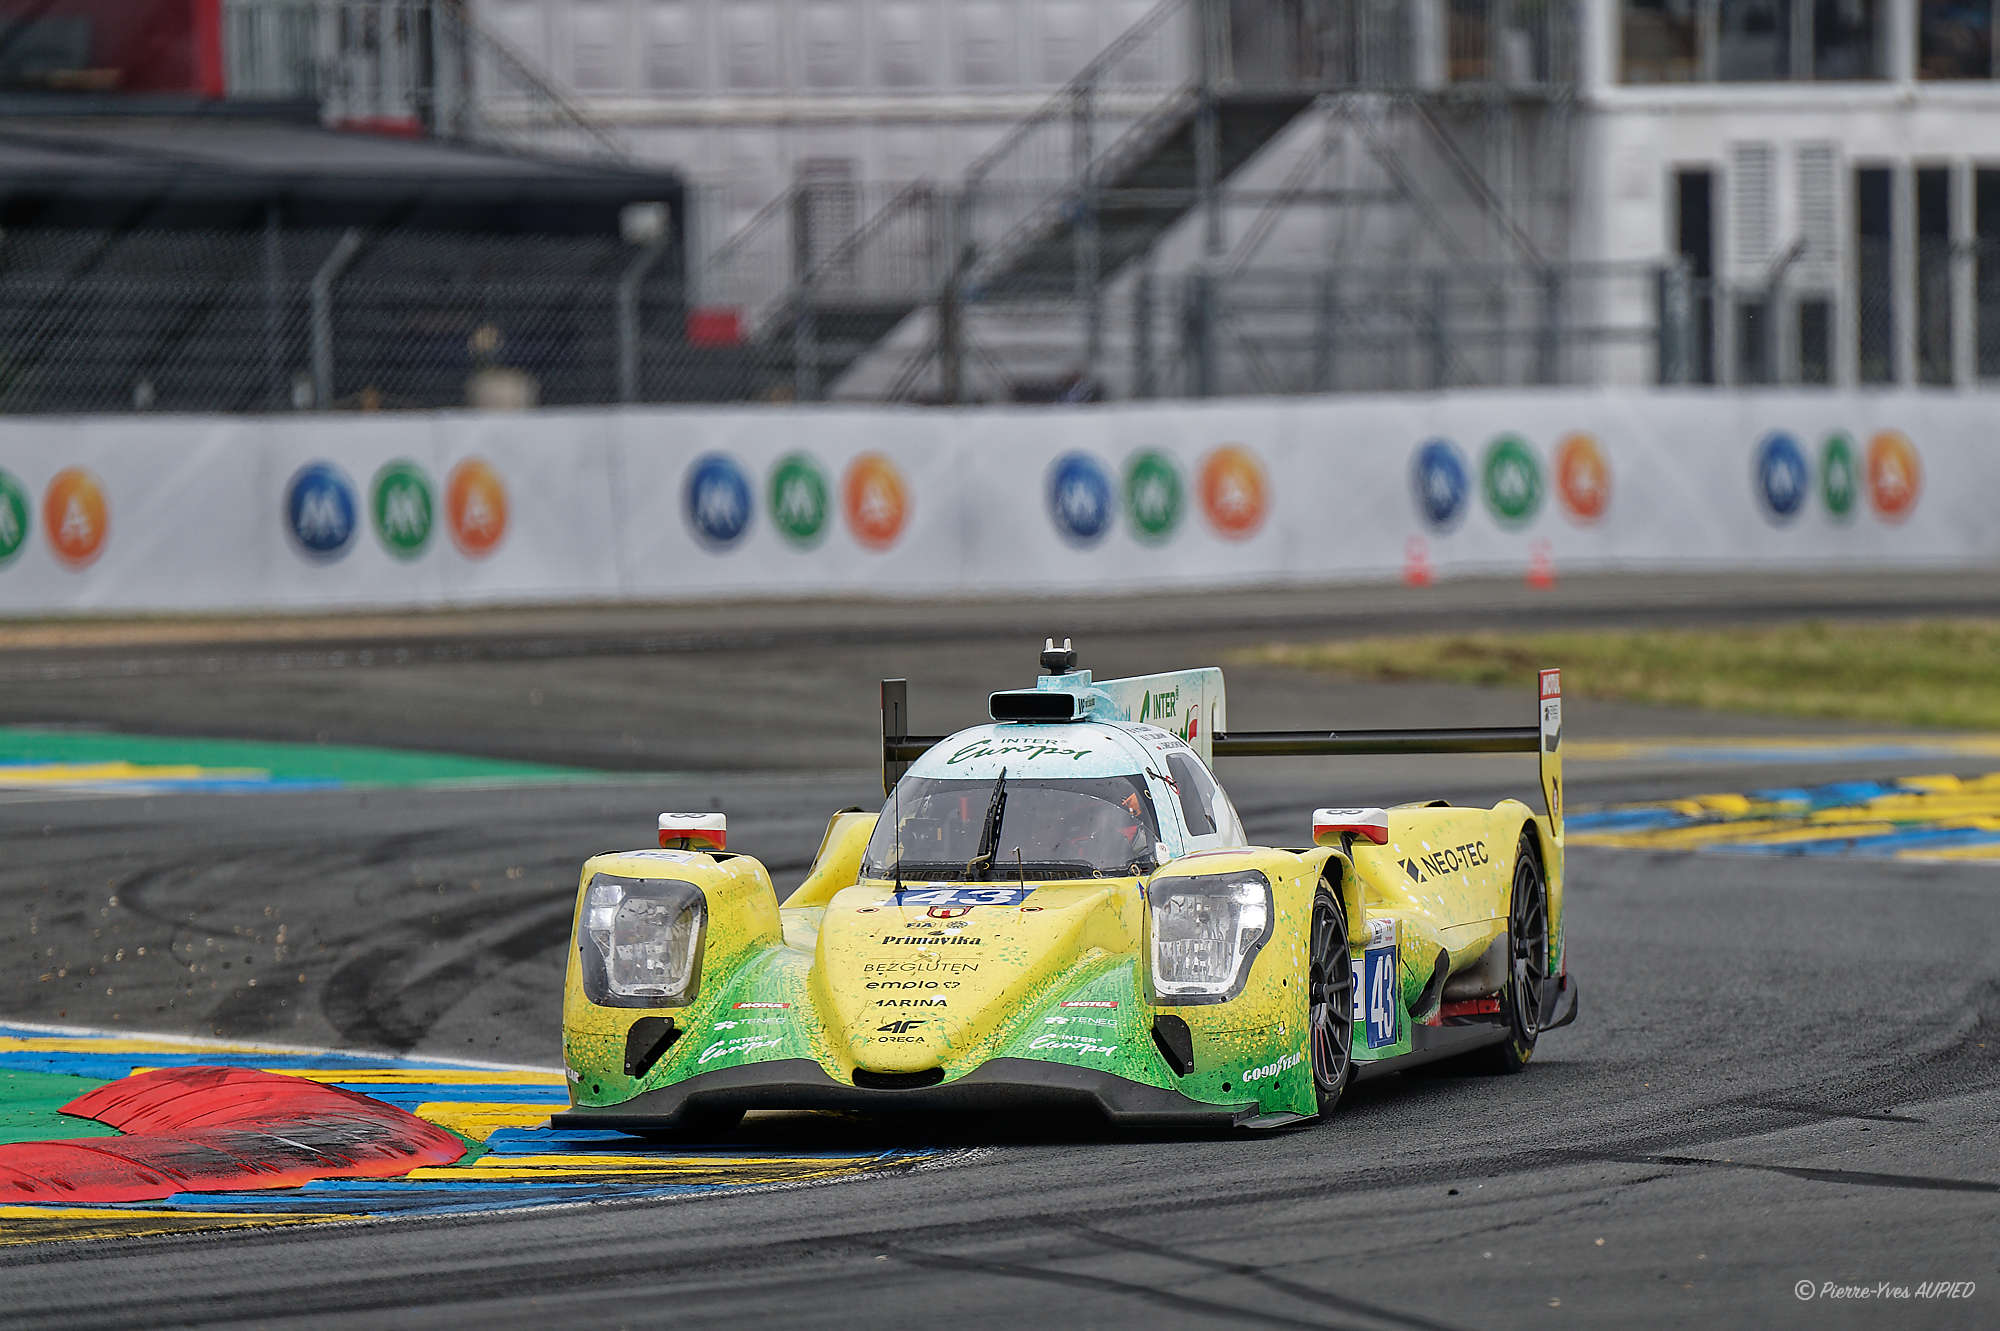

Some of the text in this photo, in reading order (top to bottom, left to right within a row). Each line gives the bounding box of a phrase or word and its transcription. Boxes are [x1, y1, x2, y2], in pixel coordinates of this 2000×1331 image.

[1153, 692, 1176, 720] INTER
[946, 739, 1092, 765] Europol
[1420, 841, 1488, 877] NEO-TEC
[903, 889, 1017, 905] 43
[882, 935, 981, 945] Primavika
[864, 963, 979, 972] BEZGLUTEN
[866, 981, 938, 990] emplo
[1371, 954, 1394, 1039] 43
[729, 1035, 763, 1044] INTER
[1029, 1034, 1118, 1056] Europol
[1061, 1034, 1097, 1043] INTER
[698, 1037, 784, 1064] Europol
[1242, 1051, 1300, 1082] GOODYEAR
